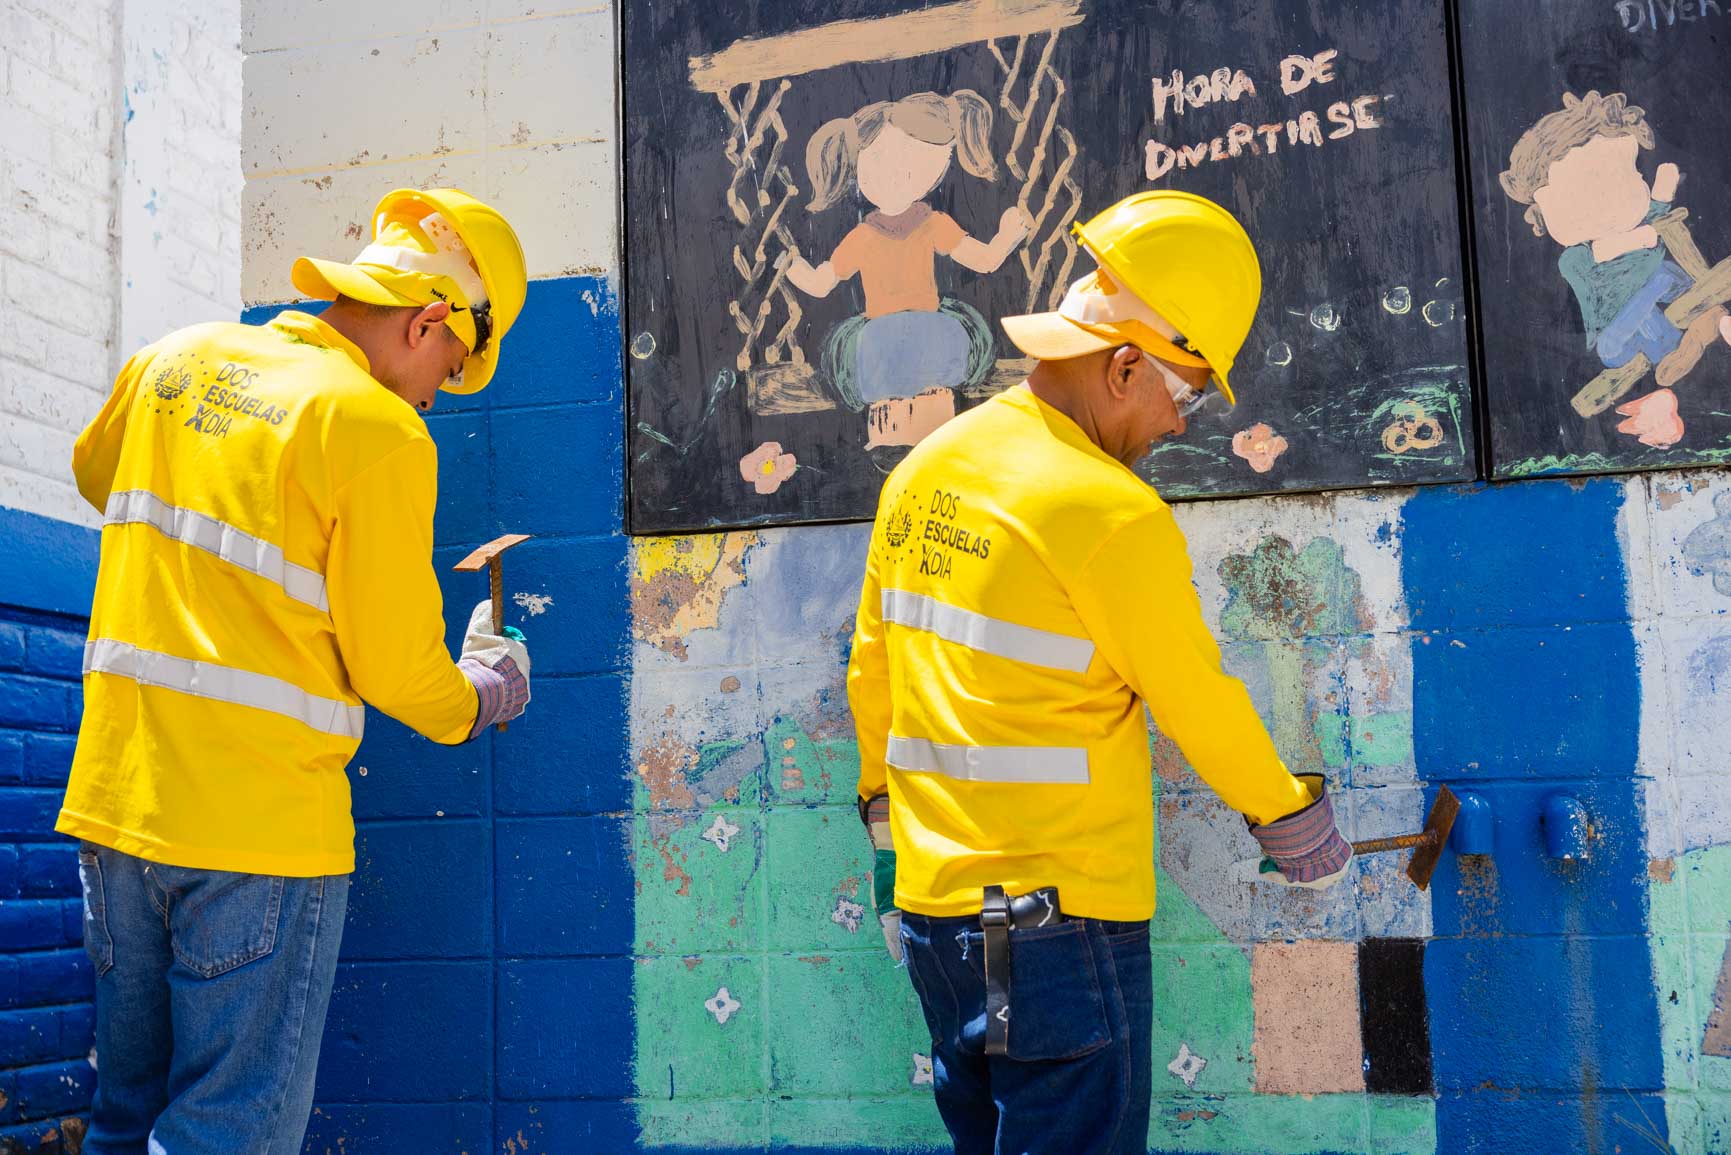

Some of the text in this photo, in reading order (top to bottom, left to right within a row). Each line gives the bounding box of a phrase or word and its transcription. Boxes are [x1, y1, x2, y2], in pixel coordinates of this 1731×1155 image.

[1614, 0, 1731, 32] DIVER
[1152, 50, 1337, 125] HORA DE
[1145, 95, 1381, 181] DIVERTIRSE
[430, 288, 448, 302] NIKE
[216, 363, 259, 389] DOS
[203, 385, 288, 425] ESCUELAS
[930, 489, 960, 520] DOS
[924, 519, 991, 559] ESCUELAS
